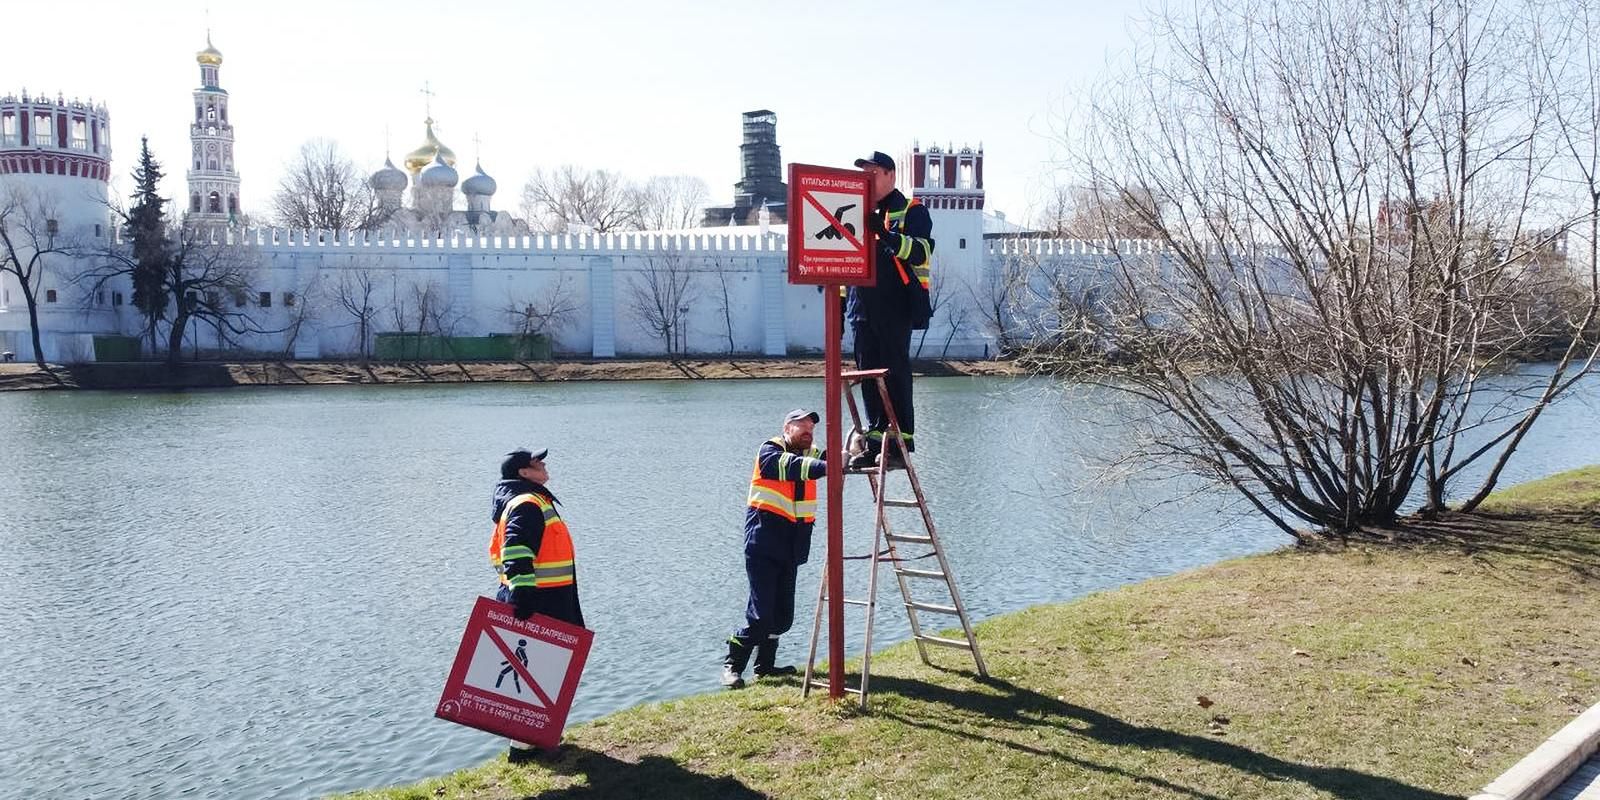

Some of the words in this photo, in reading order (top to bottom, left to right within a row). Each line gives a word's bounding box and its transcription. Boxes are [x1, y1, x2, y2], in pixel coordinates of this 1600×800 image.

[802, 177, 830, 186] КУПАТЬСЯ
[488, 610, 514, 625] ВЫХОД
[514, 619, 524, 628] НА
[524, 621, 540, 634] ЛЕД
[540, 626, 578, 644] ЗАПРЕЩЕН
[460, 690, 472, 699] При
[520, 708, 550, 722] ЗВОНИТЬ
[495, 709, 512, 720] (495)
[512, 713, 545, 728] 637-22-22
